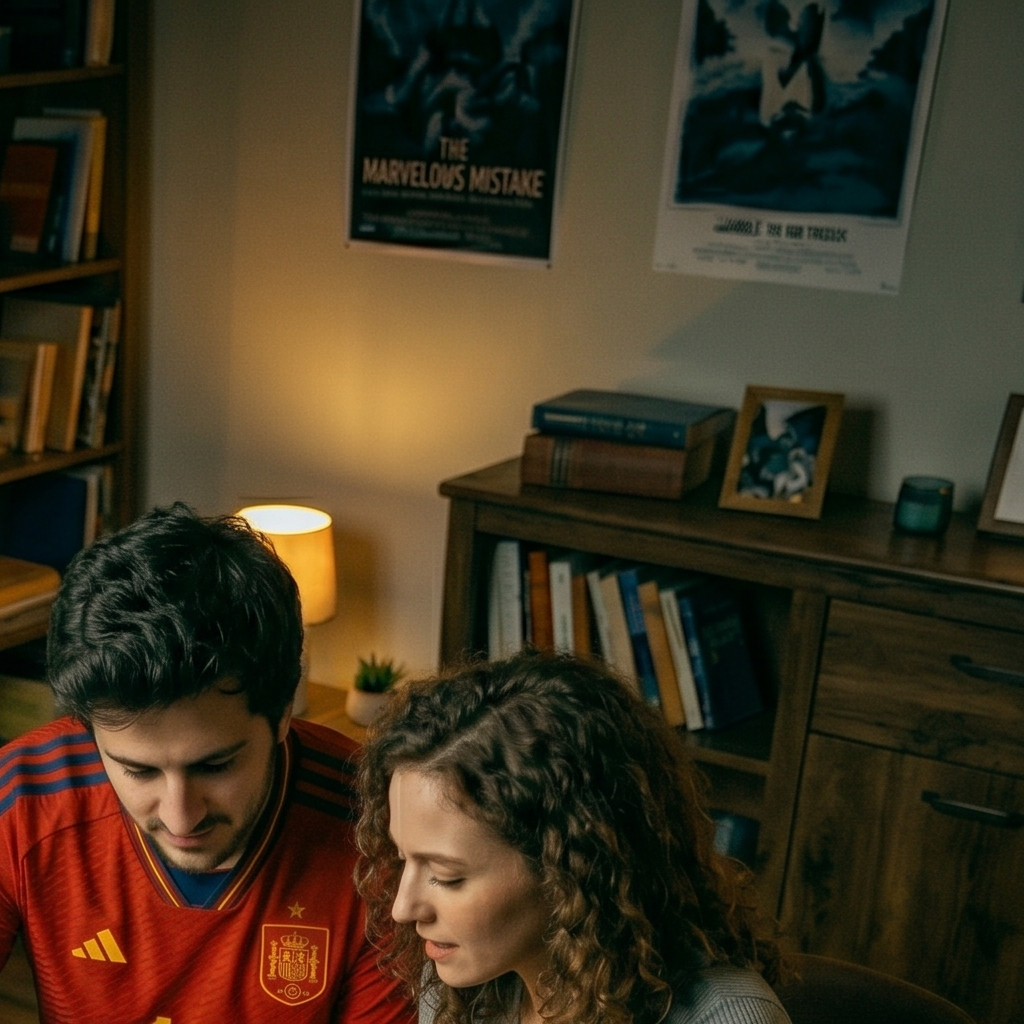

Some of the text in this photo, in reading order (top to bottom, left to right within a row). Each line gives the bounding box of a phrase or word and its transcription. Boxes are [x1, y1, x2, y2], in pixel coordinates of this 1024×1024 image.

[439, 136, 470, 161] THE
[362, 156, 466, 192] MARVELOUS
[468, 164, 546, 199] MISTAKE
